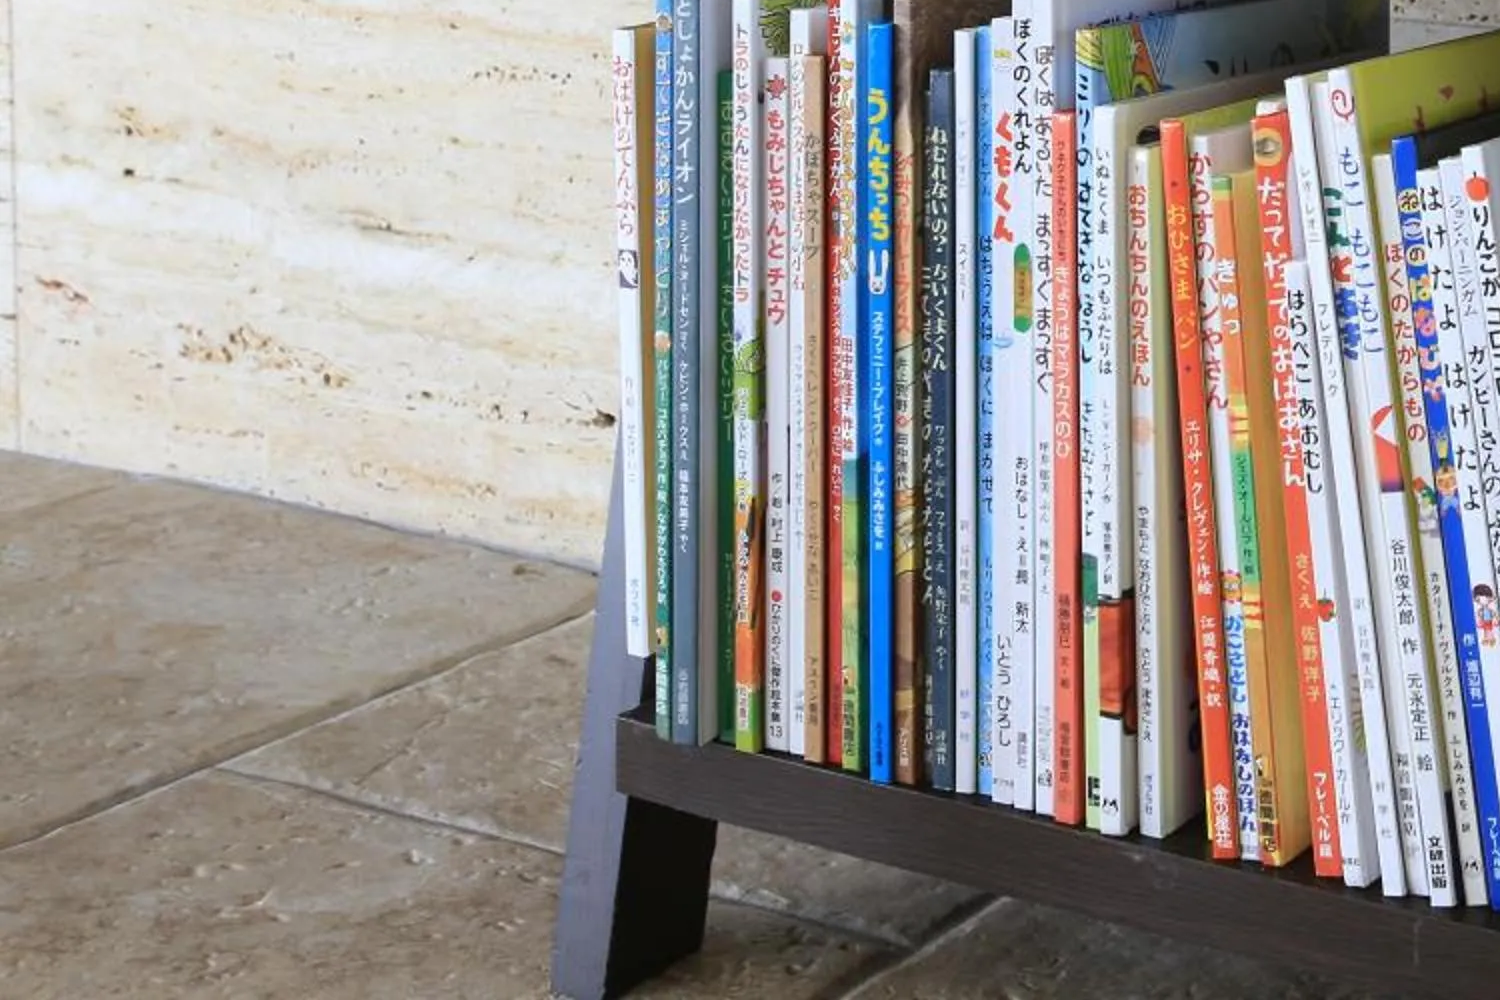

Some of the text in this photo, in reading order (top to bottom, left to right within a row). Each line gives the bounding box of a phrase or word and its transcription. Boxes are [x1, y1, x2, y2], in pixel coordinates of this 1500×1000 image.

[612, 54, 635, 235] おばけのてんぷら
[867, 87, 891, 241] うんちっち
[1013, 18, 1034, 175] ぼくのくれよん
[1077, 72, 1094, 167] ミリーの
[766, 109, 786, 326] もみじちゃんとチュウ
[1034, 45, 1055, 394] ぼくは あるいた まっすぐ まっすぐ
[1078, 179, 1094, 285] すてきな
[1095, 148, 1114, 376] いぬとくま いつもふたりは
[1128, 185, 1150, 387] おちんちんのえほん
[1166, 205, 1192, 298] おひさま
[1190, 151, 1229, 410] からすのパンやさん
[931, 262, 949, 371] ちいくまくん
[1054, 265, 1073, 459] きょうはマラカスのひ
[1286, 288, 1324, 494] はらぺこ あおむし
[1317, 303, 1338, 398] フレデリック
[1385, 242, 1428, 442] ぼくのたからもの
[1420, 186, 1482, 511] はけたよ はけたよ
[996, 633, 1013, 748] いとう ひろし
[1390, 539, 1434, 772] 谷川俊太郎 作 元永定正 絵
[1232, 713, 1256, 831] おはなしのほん
[1313, 772, 1333, 857] フレーベル館
